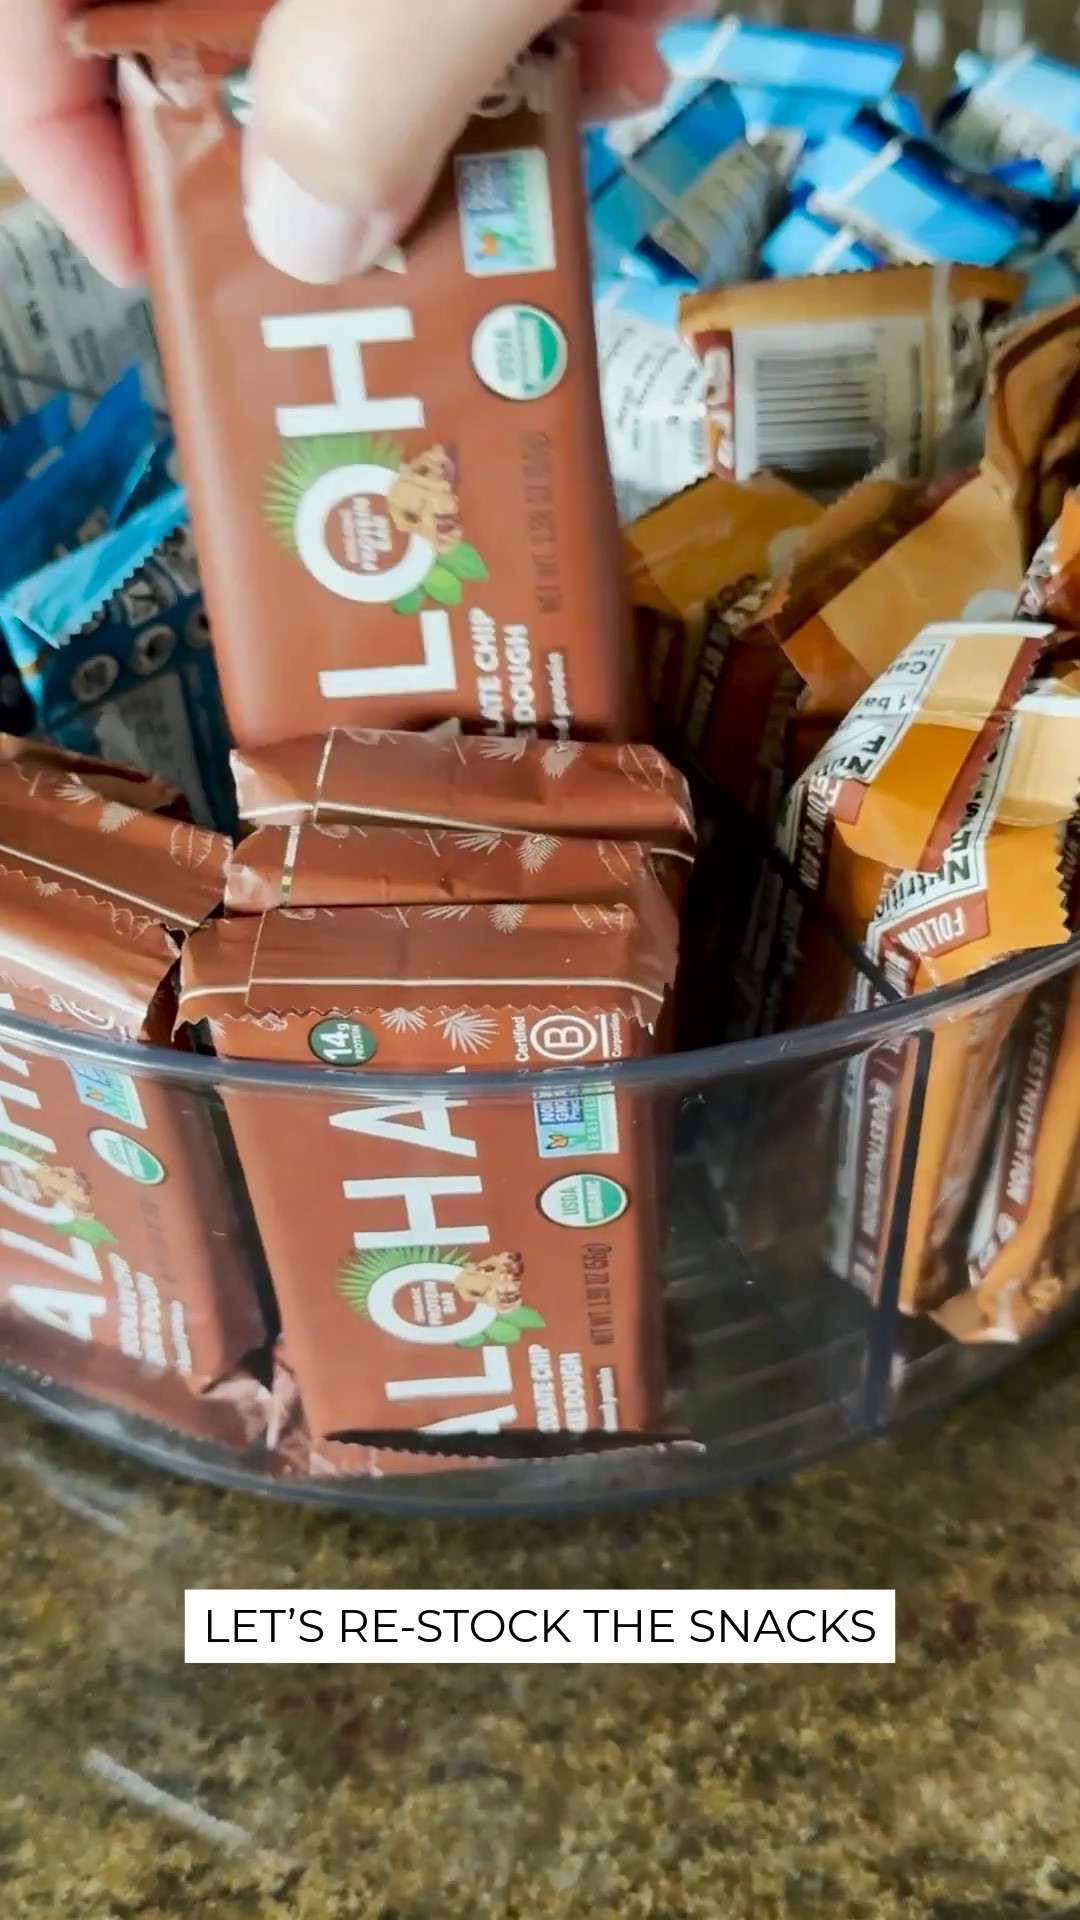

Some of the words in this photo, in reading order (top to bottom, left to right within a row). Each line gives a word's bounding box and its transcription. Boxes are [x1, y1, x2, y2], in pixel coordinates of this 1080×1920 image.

[261, 246, 464, 734] LOH
[503, 624, 537, 722] DOUGH
[511, 1016, 530, 1062] Certified
[560, 1186, 580, 1216] USDA
